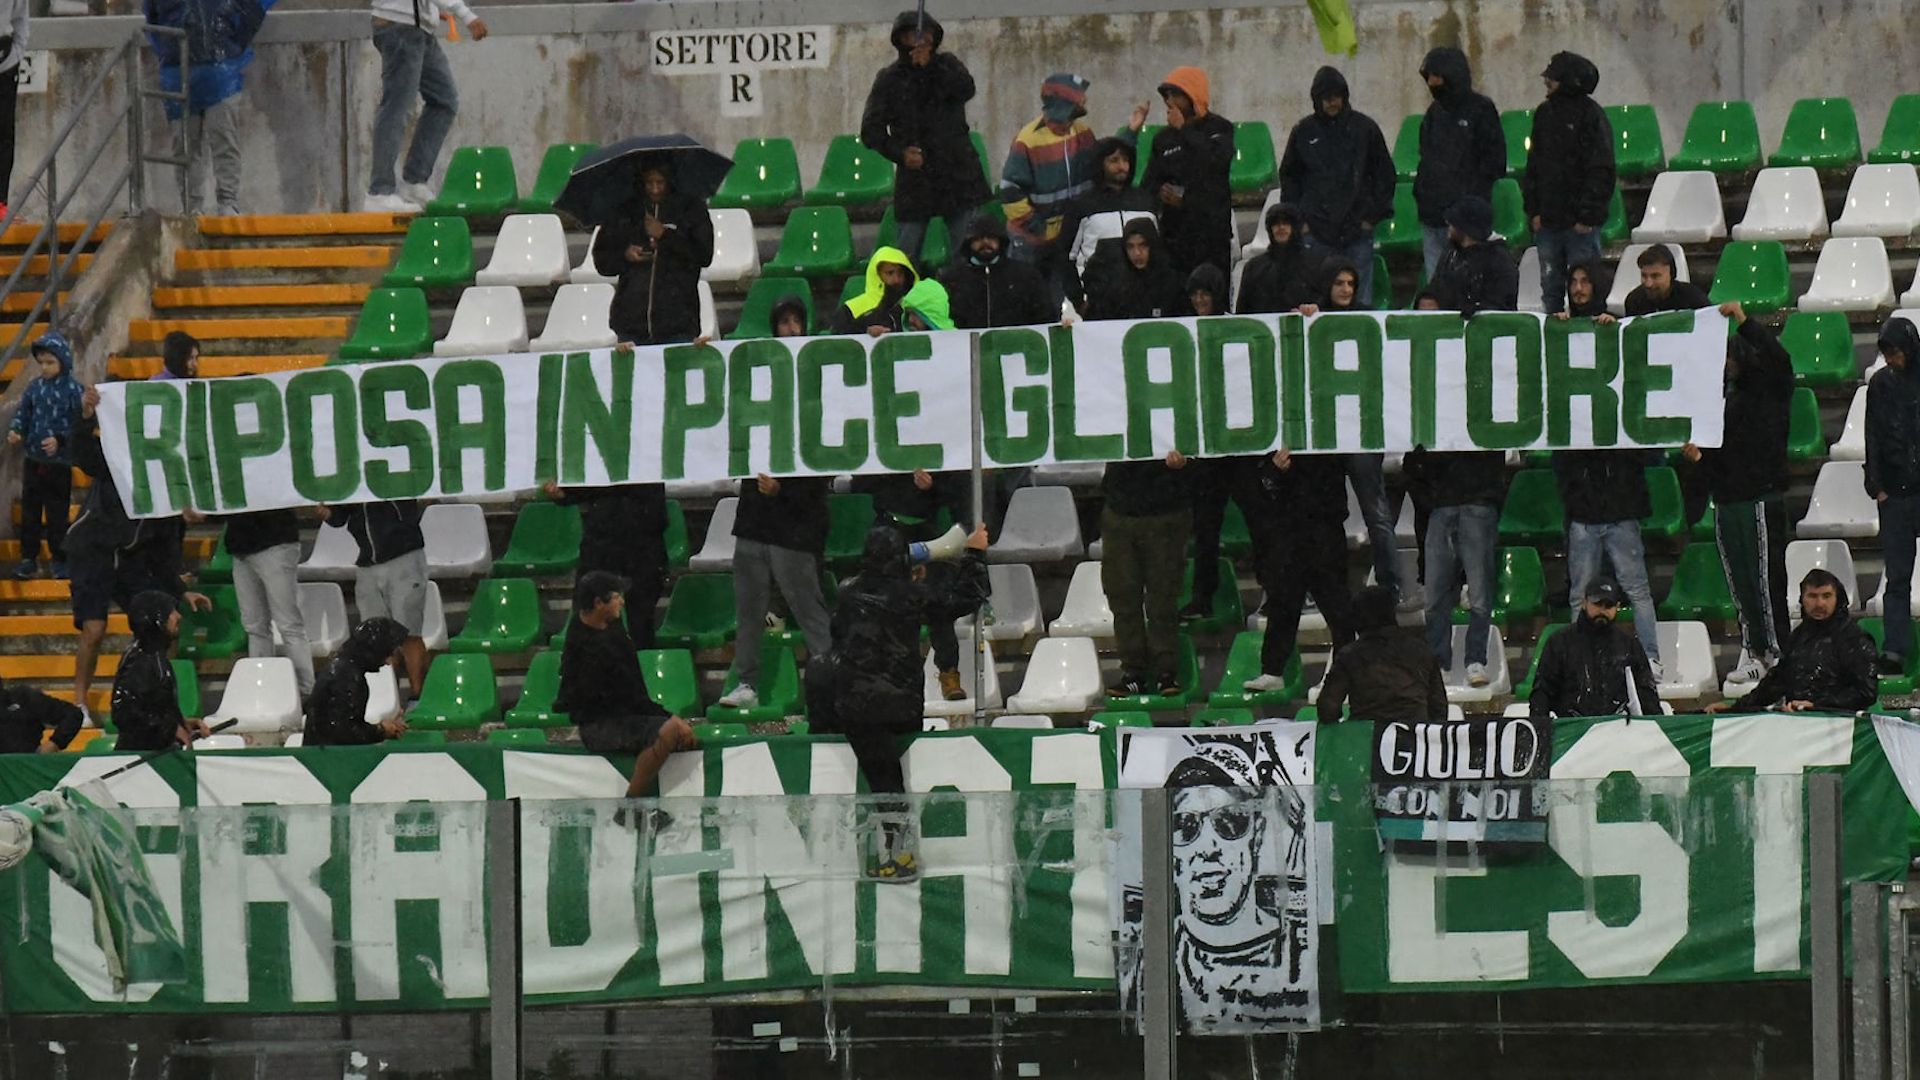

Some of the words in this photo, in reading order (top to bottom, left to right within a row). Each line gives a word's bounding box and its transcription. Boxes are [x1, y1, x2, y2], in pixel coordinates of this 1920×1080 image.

[655, 31, 817, 66] SETTORE
[729, 73, 754, 102] R
[125, 359, 506, 515] RIPOSA
[534, 350, 635, 484] IN
[661, 335, 944, 479] PACE
[979, 310, 1696, 465] GLADIATORE
[1379, 718, 1538, 779] GIULIO
[1385, 786, 1443, 817] CON
[1460, 787, 1521, 820] NOI
